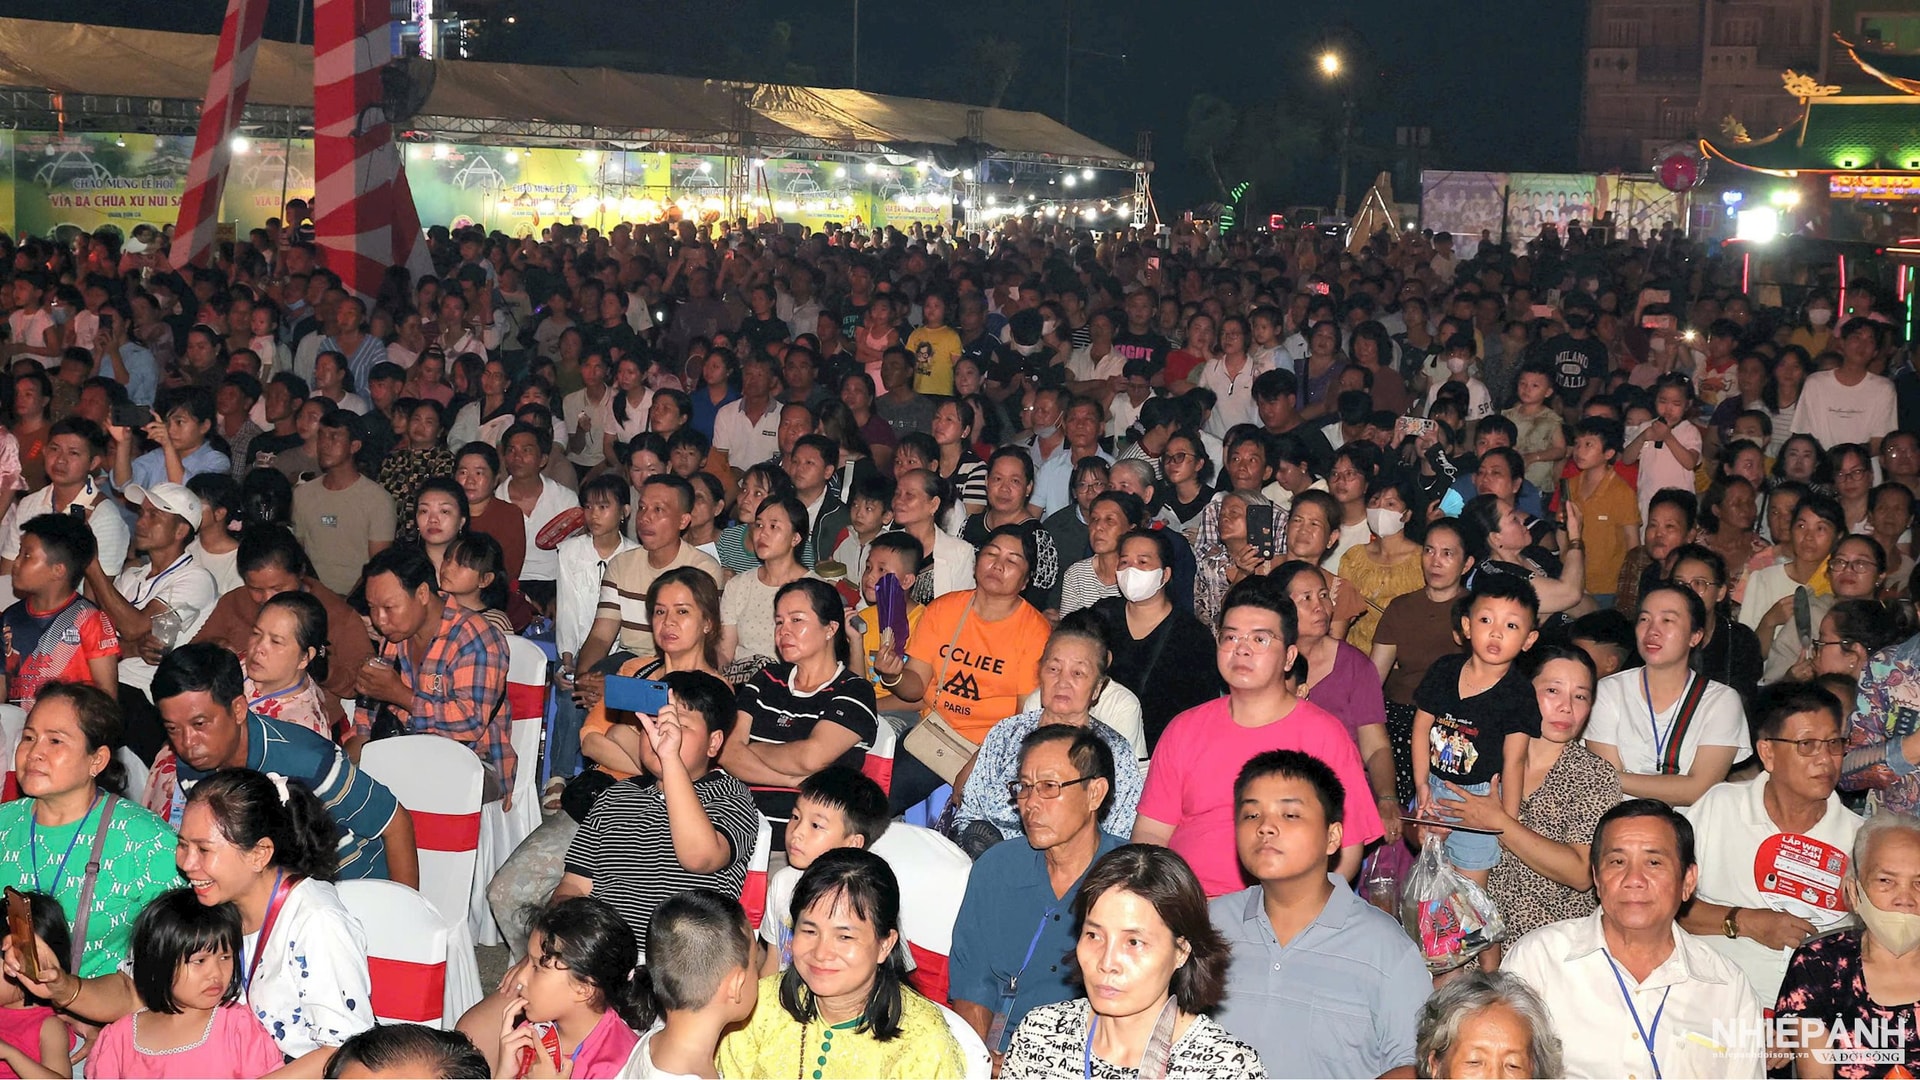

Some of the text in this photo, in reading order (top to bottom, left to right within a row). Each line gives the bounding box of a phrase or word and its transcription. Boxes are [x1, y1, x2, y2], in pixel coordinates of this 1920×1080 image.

[1555, 351, 1588, 368] MILANO
[944, 701, 971, 715] PARIS
[1802, 842, 1823, 854] WIFI
[1802, 849, 1821, 860] 24H
